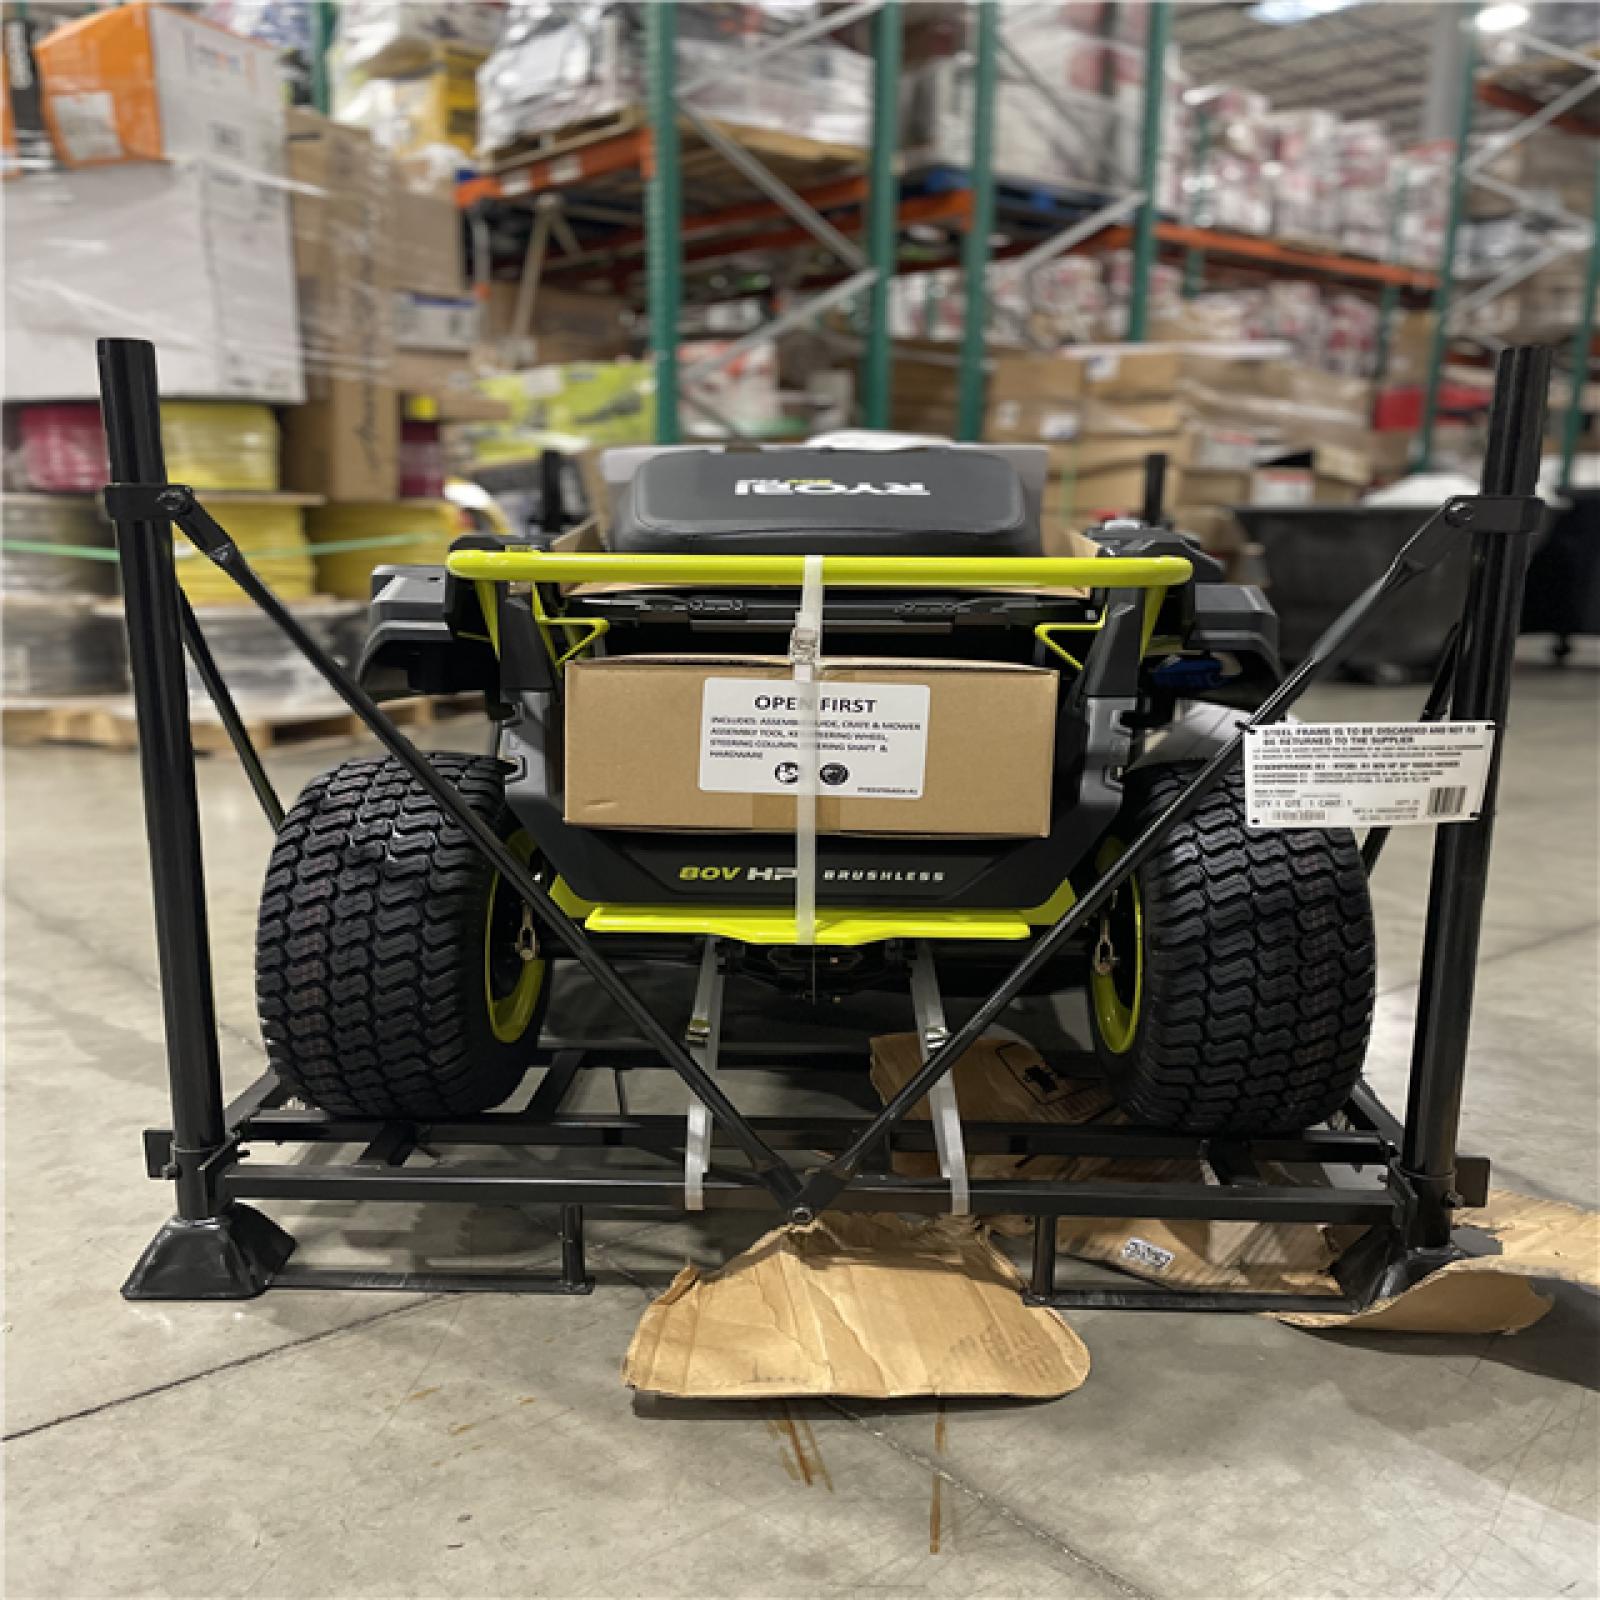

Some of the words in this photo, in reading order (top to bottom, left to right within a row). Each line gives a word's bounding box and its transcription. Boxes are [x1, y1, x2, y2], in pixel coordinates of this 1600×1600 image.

[735, 479, 931, 496] RYOBI
[819, 697, 878, 713] FIRST
[1347, 727, 1360, 735] TO
[1351, 737, 1368, 745] THE
[1371, 736, 1414, 745] SUPPLIER
[679, 866, 742, 881] 80V
[747, 866, 799, 881] HP
[823, 869, 945, 881] BRUSHLESS
